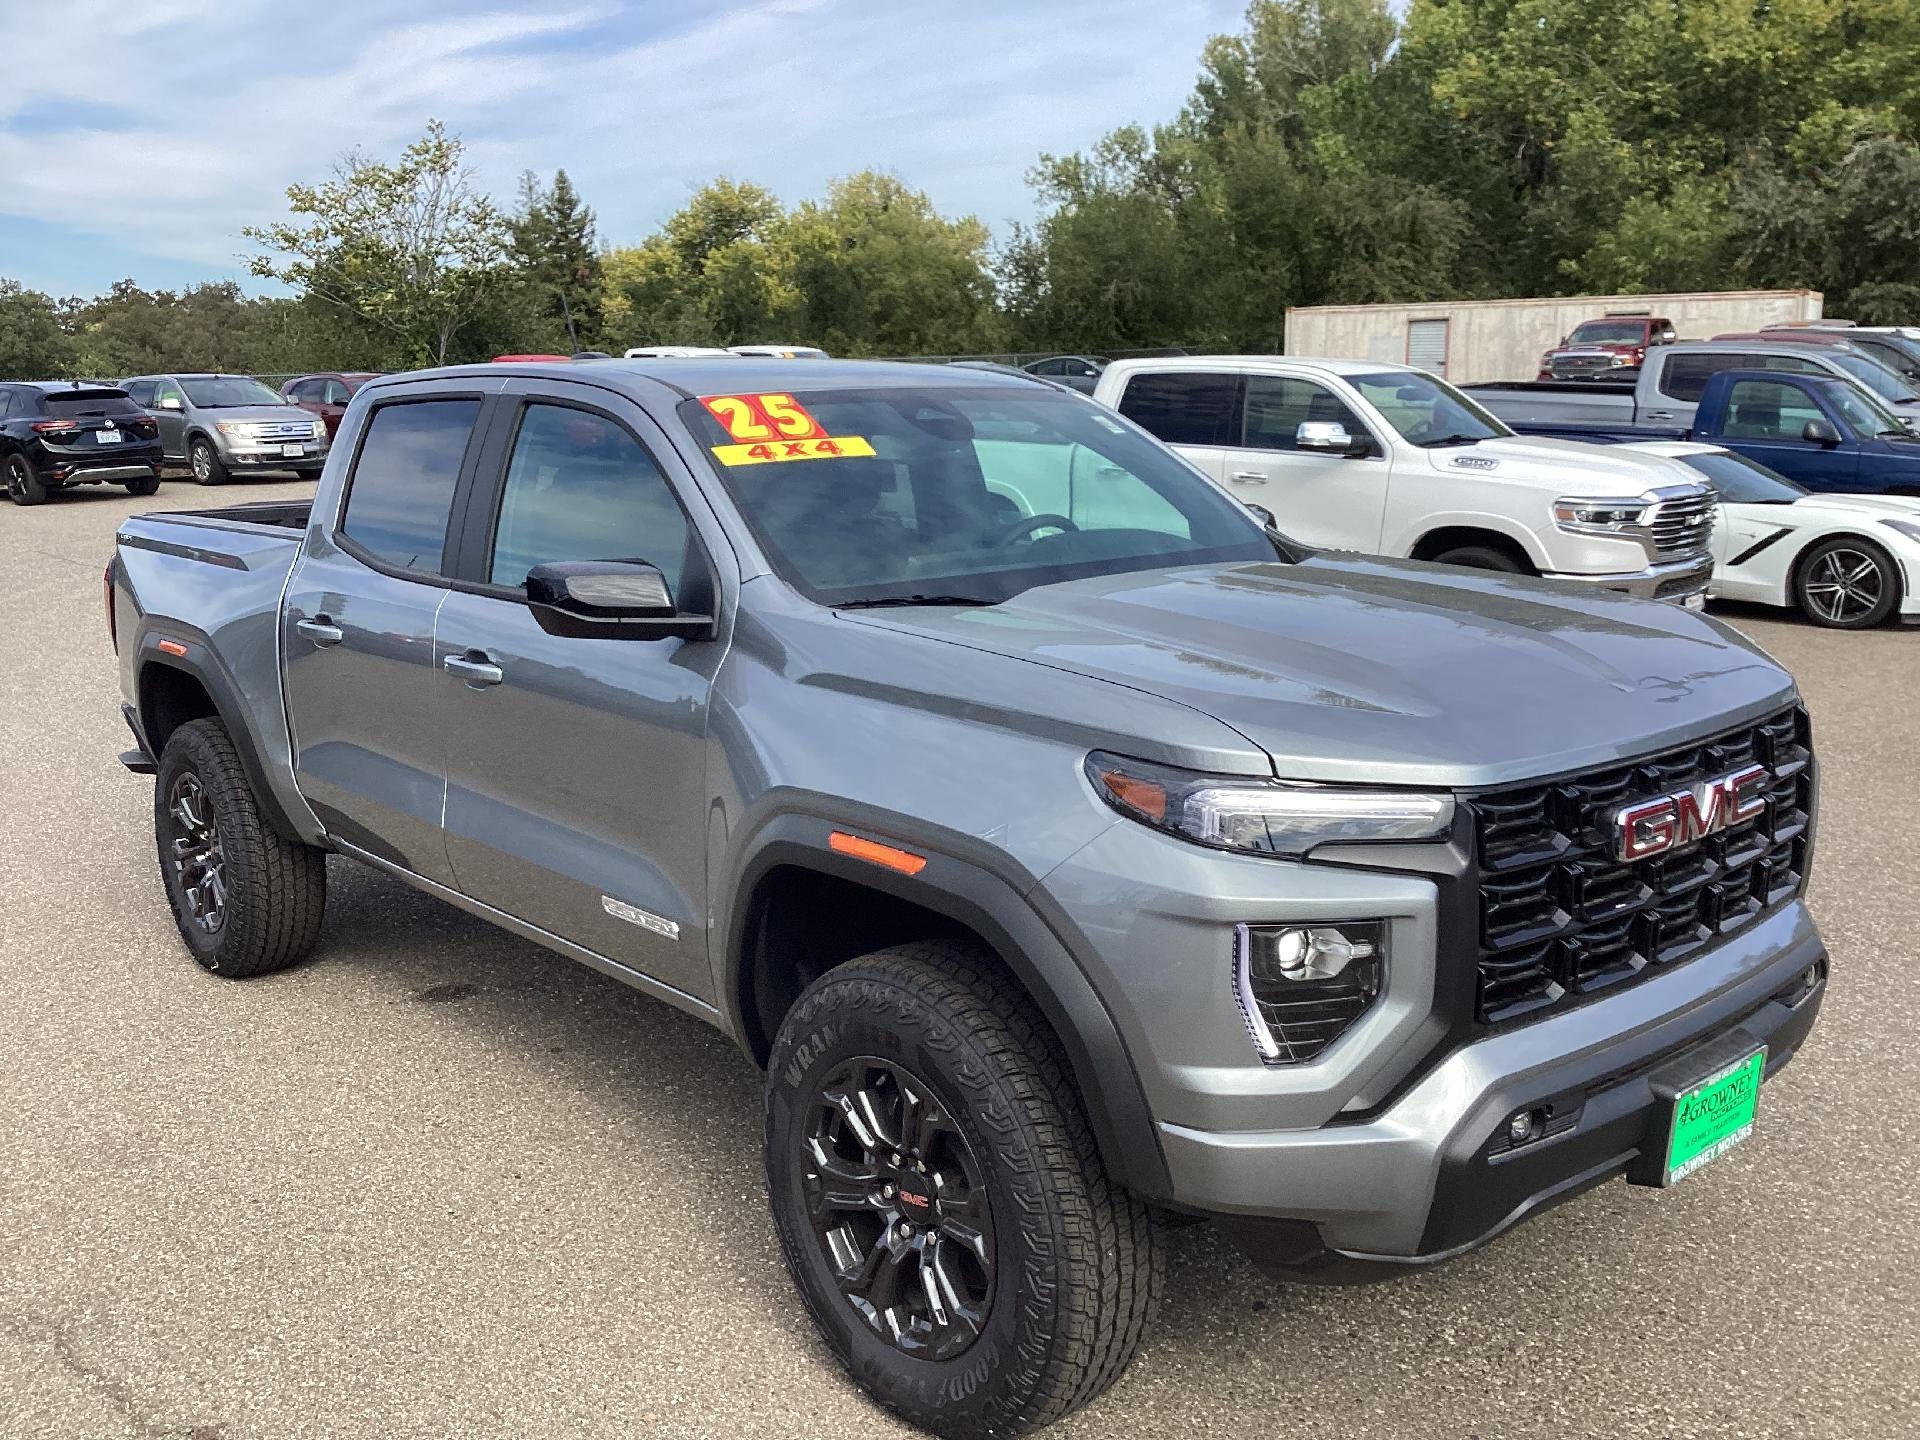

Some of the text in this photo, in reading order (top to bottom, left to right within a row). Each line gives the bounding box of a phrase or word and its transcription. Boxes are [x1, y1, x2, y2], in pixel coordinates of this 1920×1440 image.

[707, 394, 814, 440] 25
[1616, 763, 1773, 864] GMC
[1690, 1070, 1754, 1122] GROWNEY
[1670, 1145, 1717, 1184] GROWNEY
[1717, 1123, 1753, 1157] MOTORS
